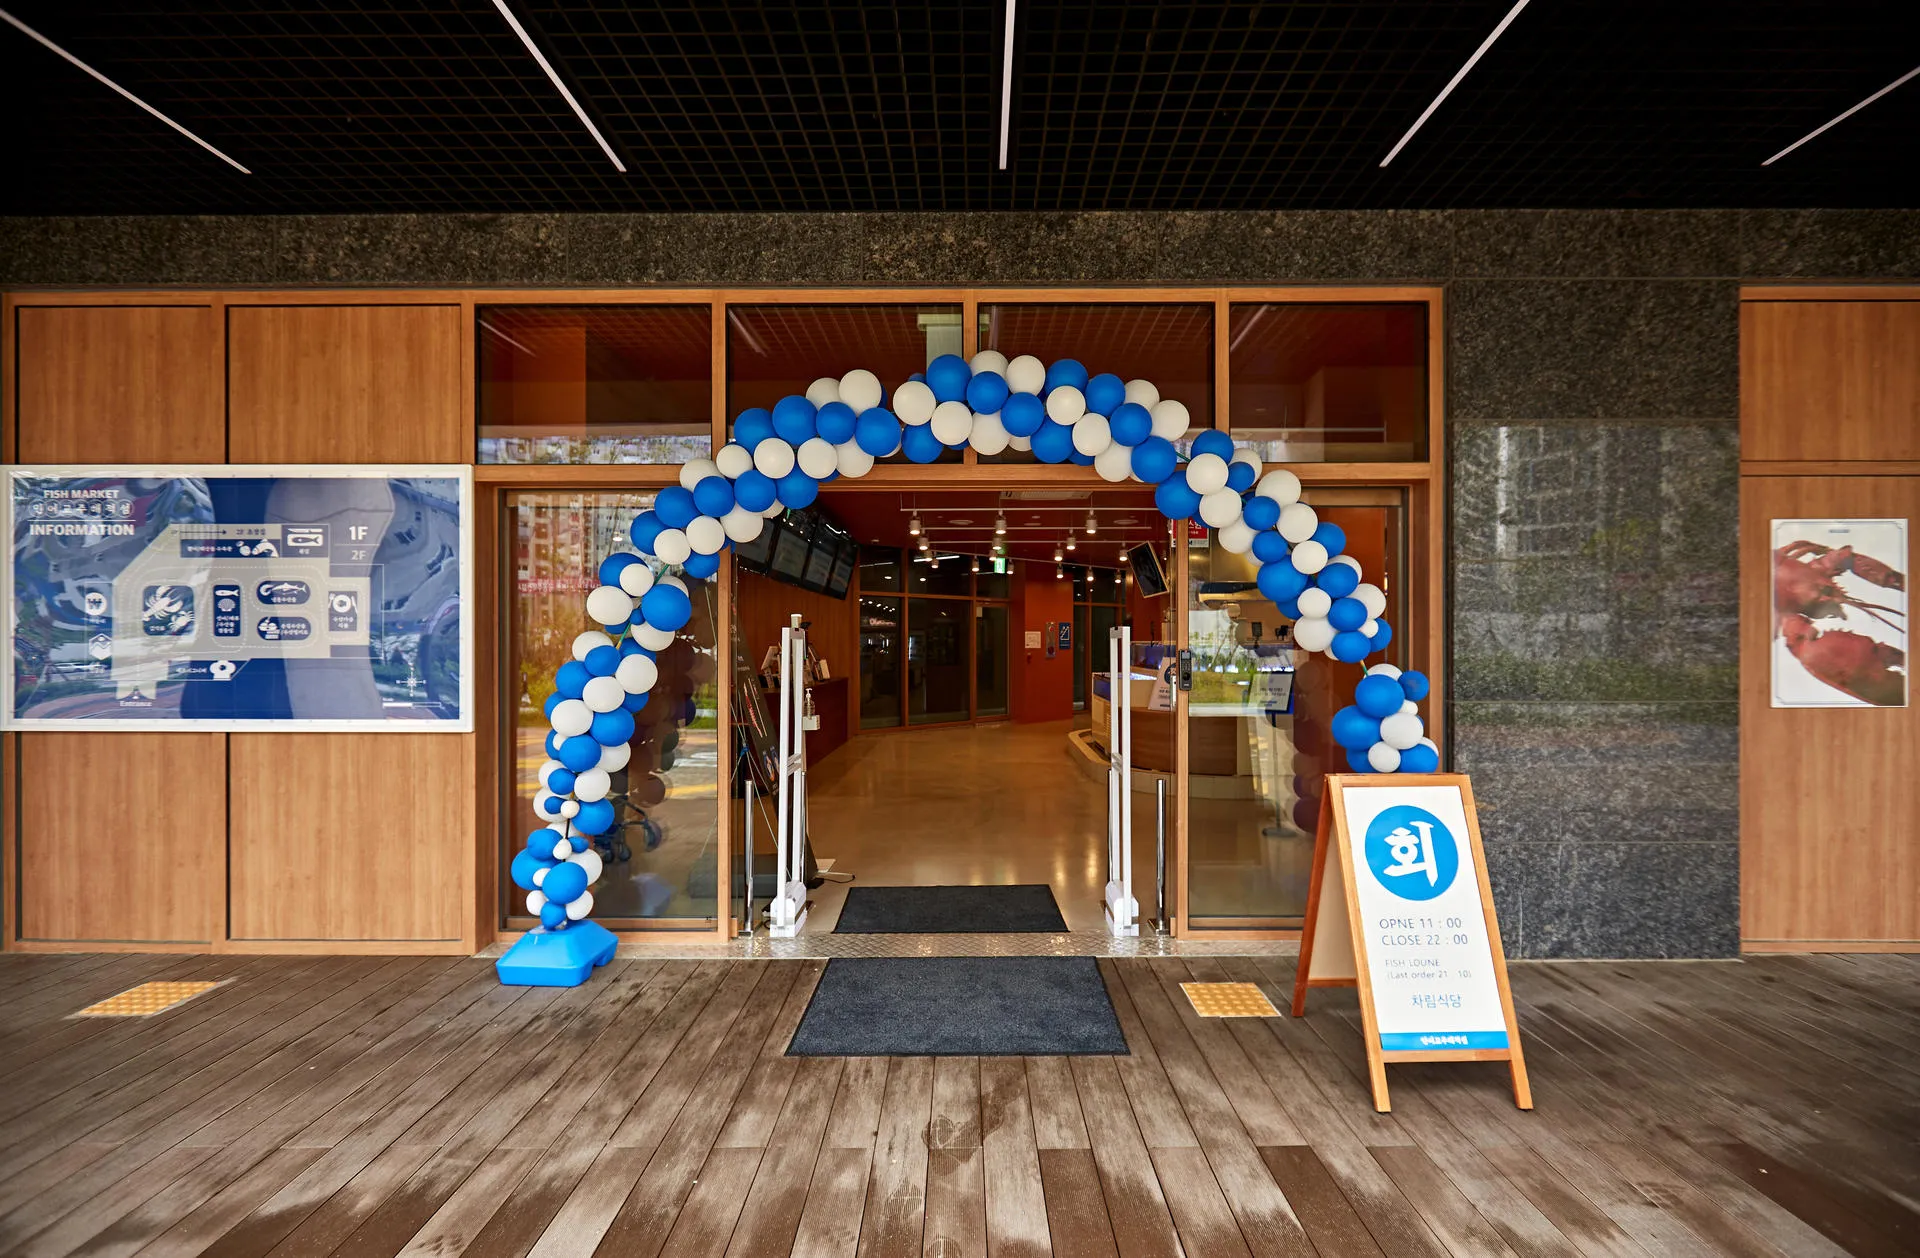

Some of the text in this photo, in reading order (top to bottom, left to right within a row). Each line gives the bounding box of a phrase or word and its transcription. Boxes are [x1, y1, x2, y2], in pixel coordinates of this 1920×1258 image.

[44, 490, 120, 499] FISH MARKET
[29, 524, 135, 536] INFORMATION
[349, 526, 368, 540] 1F
[351, 550, 366, 560] 2F
[1383, 820, 1439, 888] 회
[1379, 918, 1415, 929] OPNE
[1419, 918, 1433, 929] 11
[1446, 917, 1462, 929] 00
[1381, 934, 1421, 946] CLOSE
[1426, 934, 1440, 946] 22
[1453, 933, 1468, 945] 00
[1385, 959, 1440, 967] FISH LOUNE
[1411, 971, 1435, 979] order
[1411, 993, 1462, 1009] 차림식당
